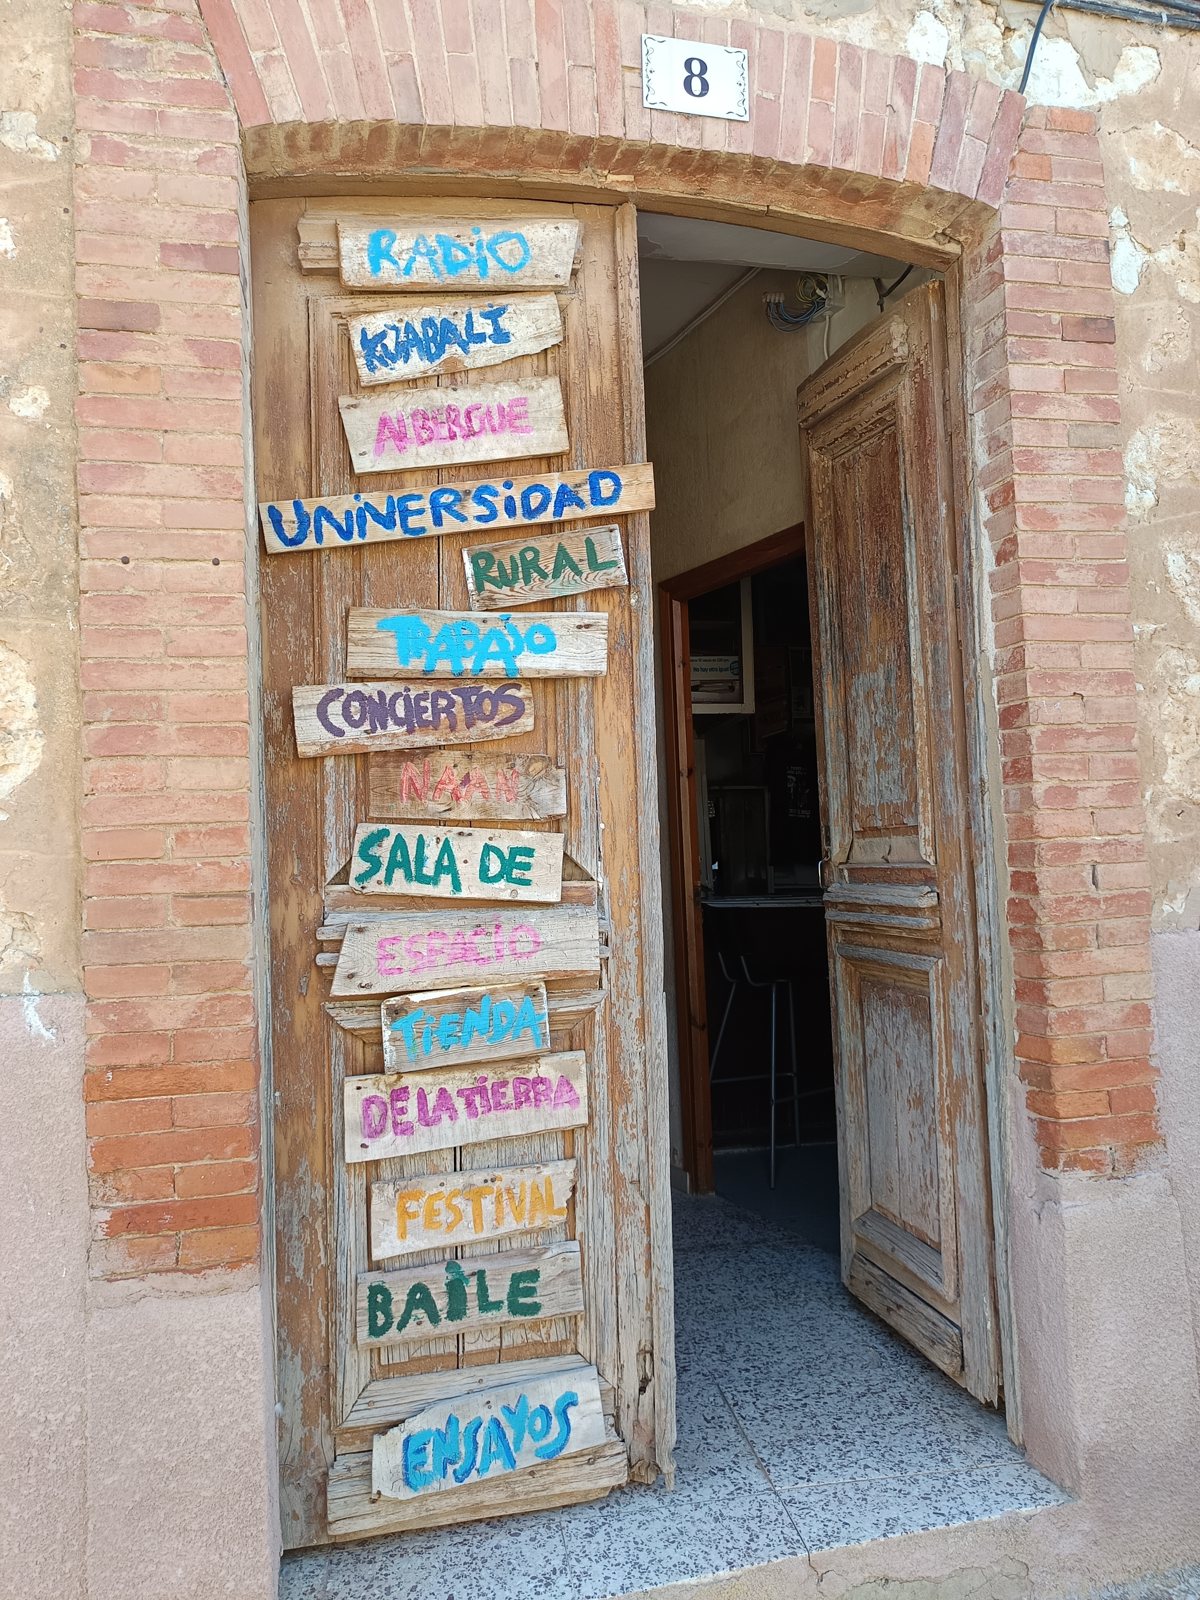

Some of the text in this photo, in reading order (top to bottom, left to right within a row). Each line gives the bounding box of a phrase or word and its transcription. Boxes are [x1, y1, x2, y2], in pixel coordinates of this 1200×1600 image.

[683, 57, 710, 98] 8
[372, 396, 534, 457] ALBERGUE
[471, 537, 618, 593] RURAL
[354, 828, 536, 894] SALA DE
[402, 1391, 578, 1492] ENSAYOS
